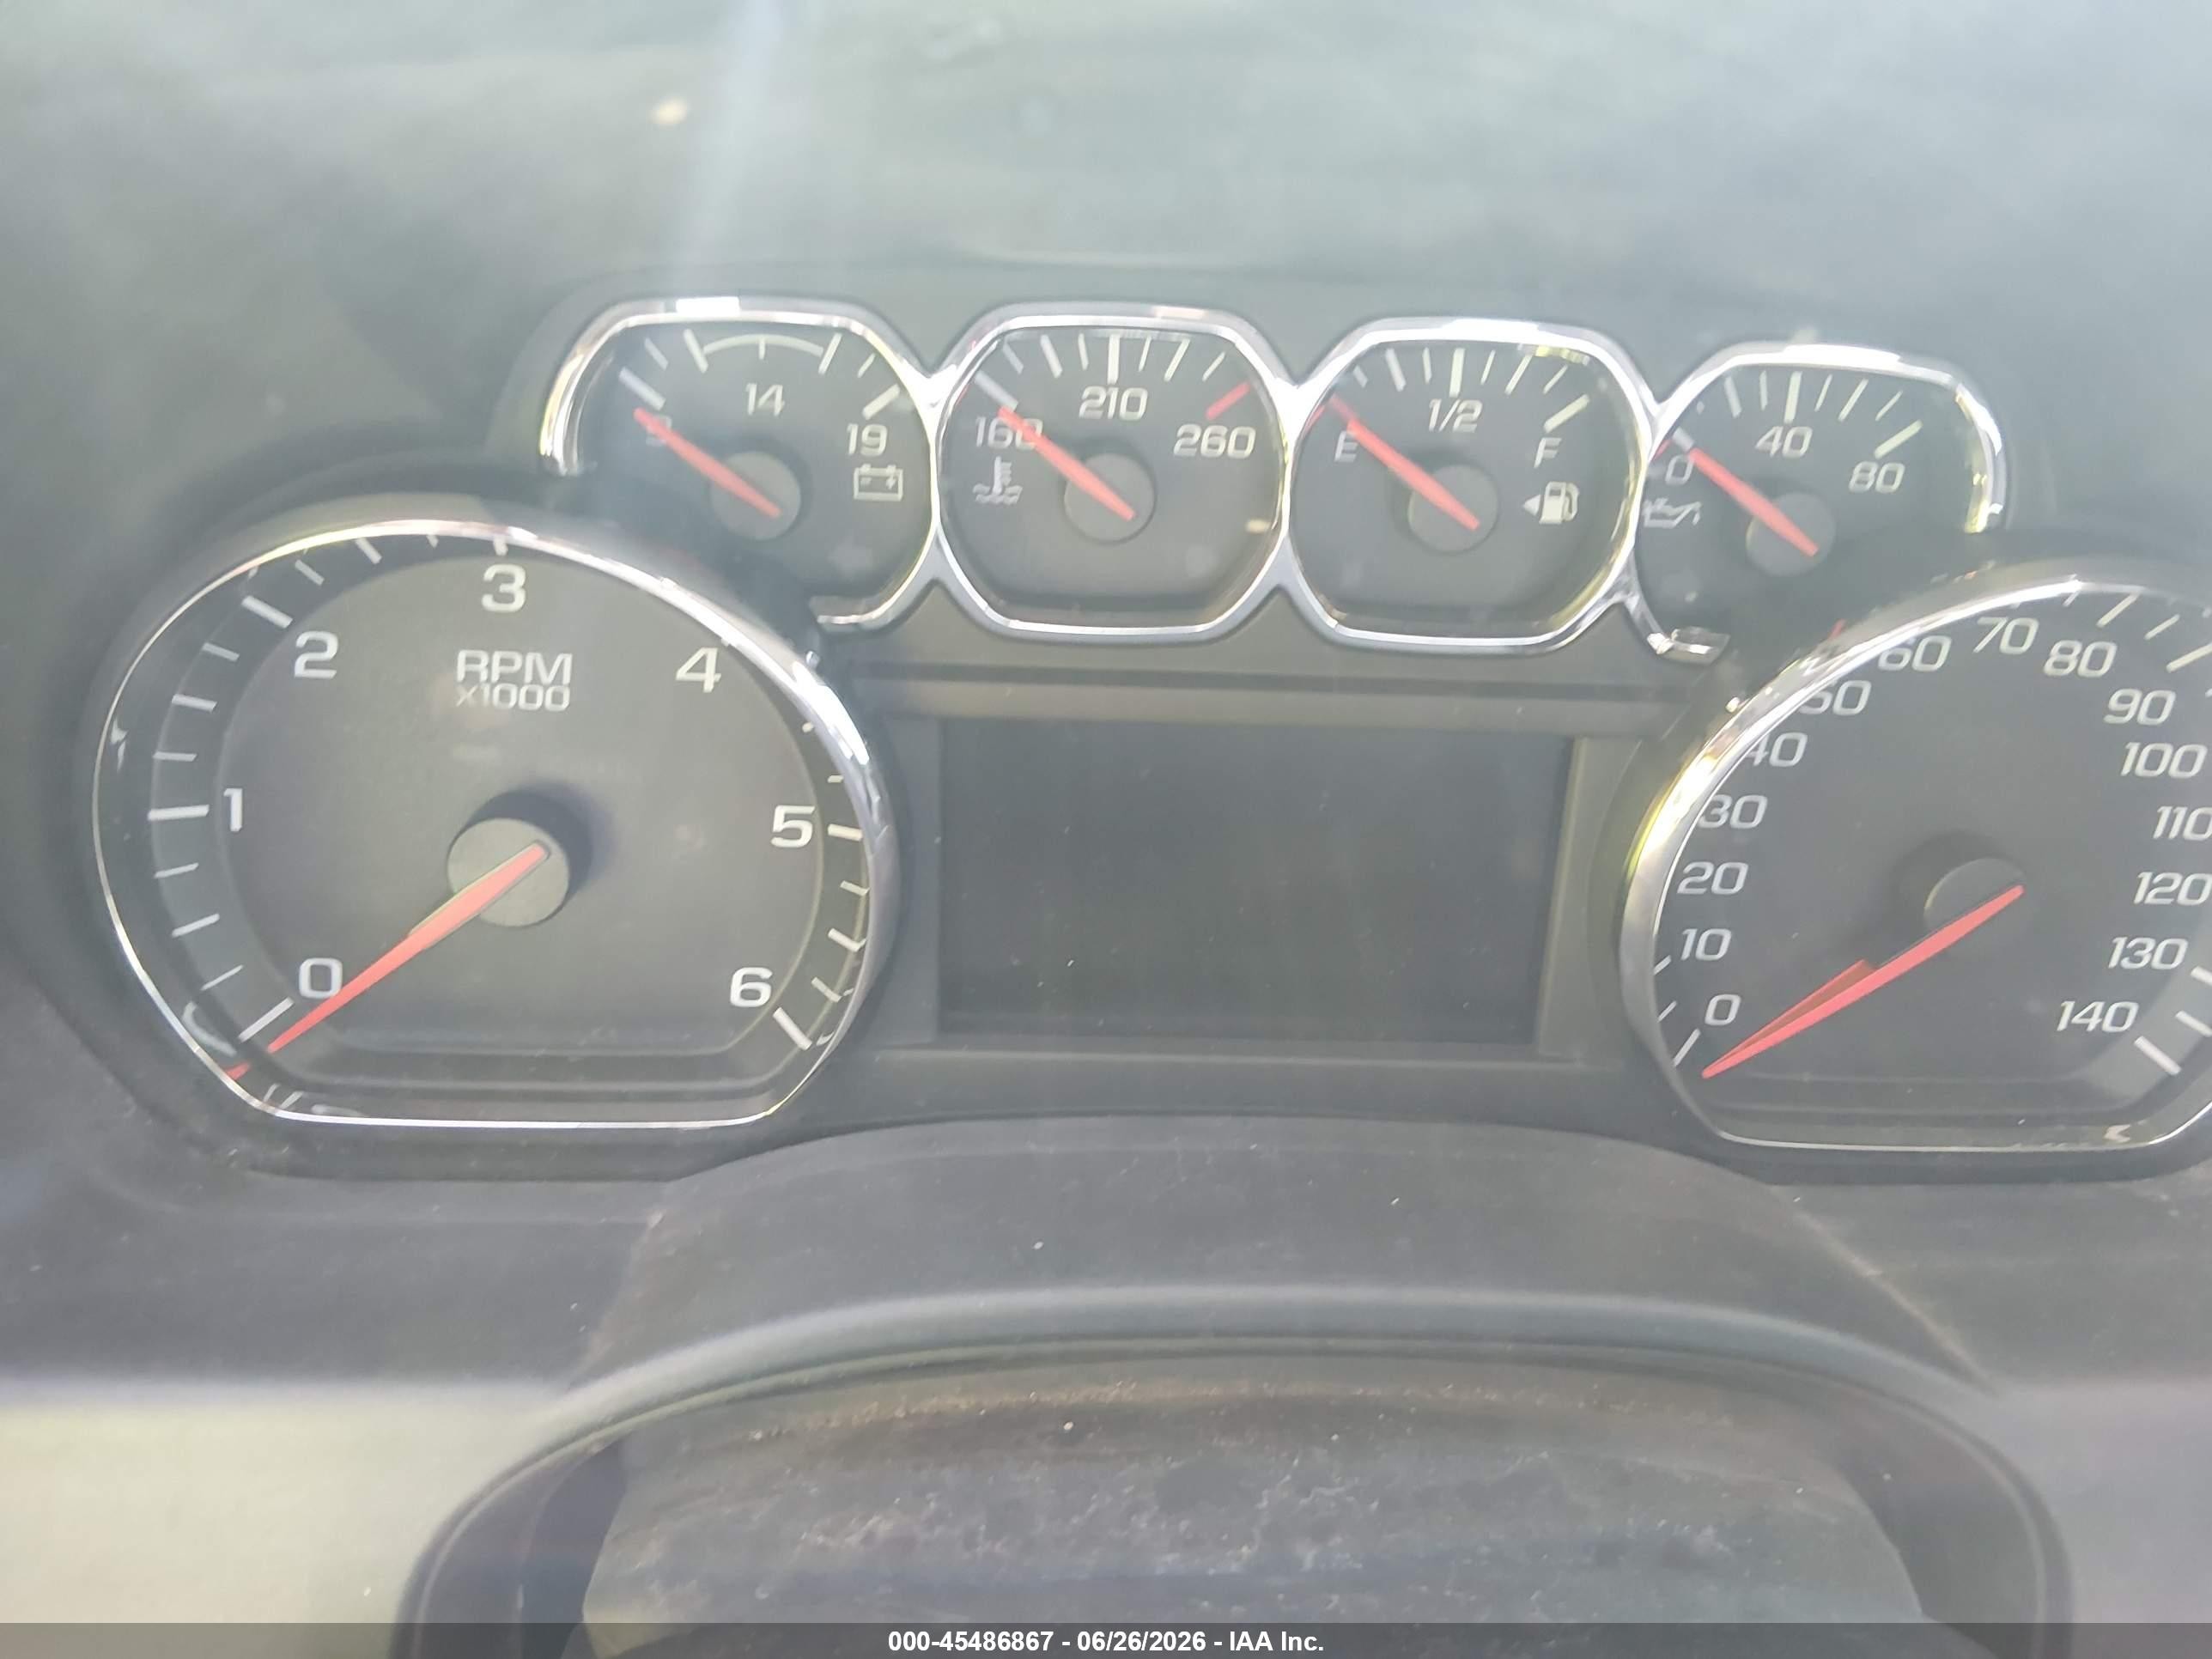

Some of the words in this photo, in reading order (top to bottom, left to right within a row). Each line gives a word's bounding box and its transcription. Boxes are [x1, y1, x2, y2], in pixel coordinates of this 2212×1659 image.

[745, 383, 785, 416] 14
[1079, 386, 1147, 421] 210
[1427, 398, 1483, 433] 1/2
[846, 423, 888, 455] 19
[976, 416, 1043, 450] 160
[1173, 424, 1255, 459] 260
[1334, 429, 1358, 463] E
[1755, 426, 1813, 458] 40
[1534, 437, 1563, 470] F
[1849, 461, 1905, 494] 80
[481, 563, 526, 612] 3
[1973, 616, 2039, 655] 70
[294, 632, 338, 679] 2
[456, 651, 573, 685] RPM
[676, 647, 721, 693] 4
[1878, 635, 1952, 672] 60
[2043, 640, 2118, 678] 80
[2104, 688, 2177, 726] 90
[2120, 741, 2209, 779] 100
[222, 788, 243, 832] 1
[770, 805, 815, 848] 5
[1698, 793, 1768, 830] 30
[2153, 805, 2212, 841] 110
[1677, 861, 1748, 896] 20
[2134, 872, 2212, 905] 120
[1680, 928, 1732, 961] 10
[2108, 937, 2189, 969] 130
[299, 957, 343, 1000] 0
[728, 966, 772, 1008] 6
[1705, 994, 1741, 1026] 0
[2056, 1000, 2138, 1033] 140
